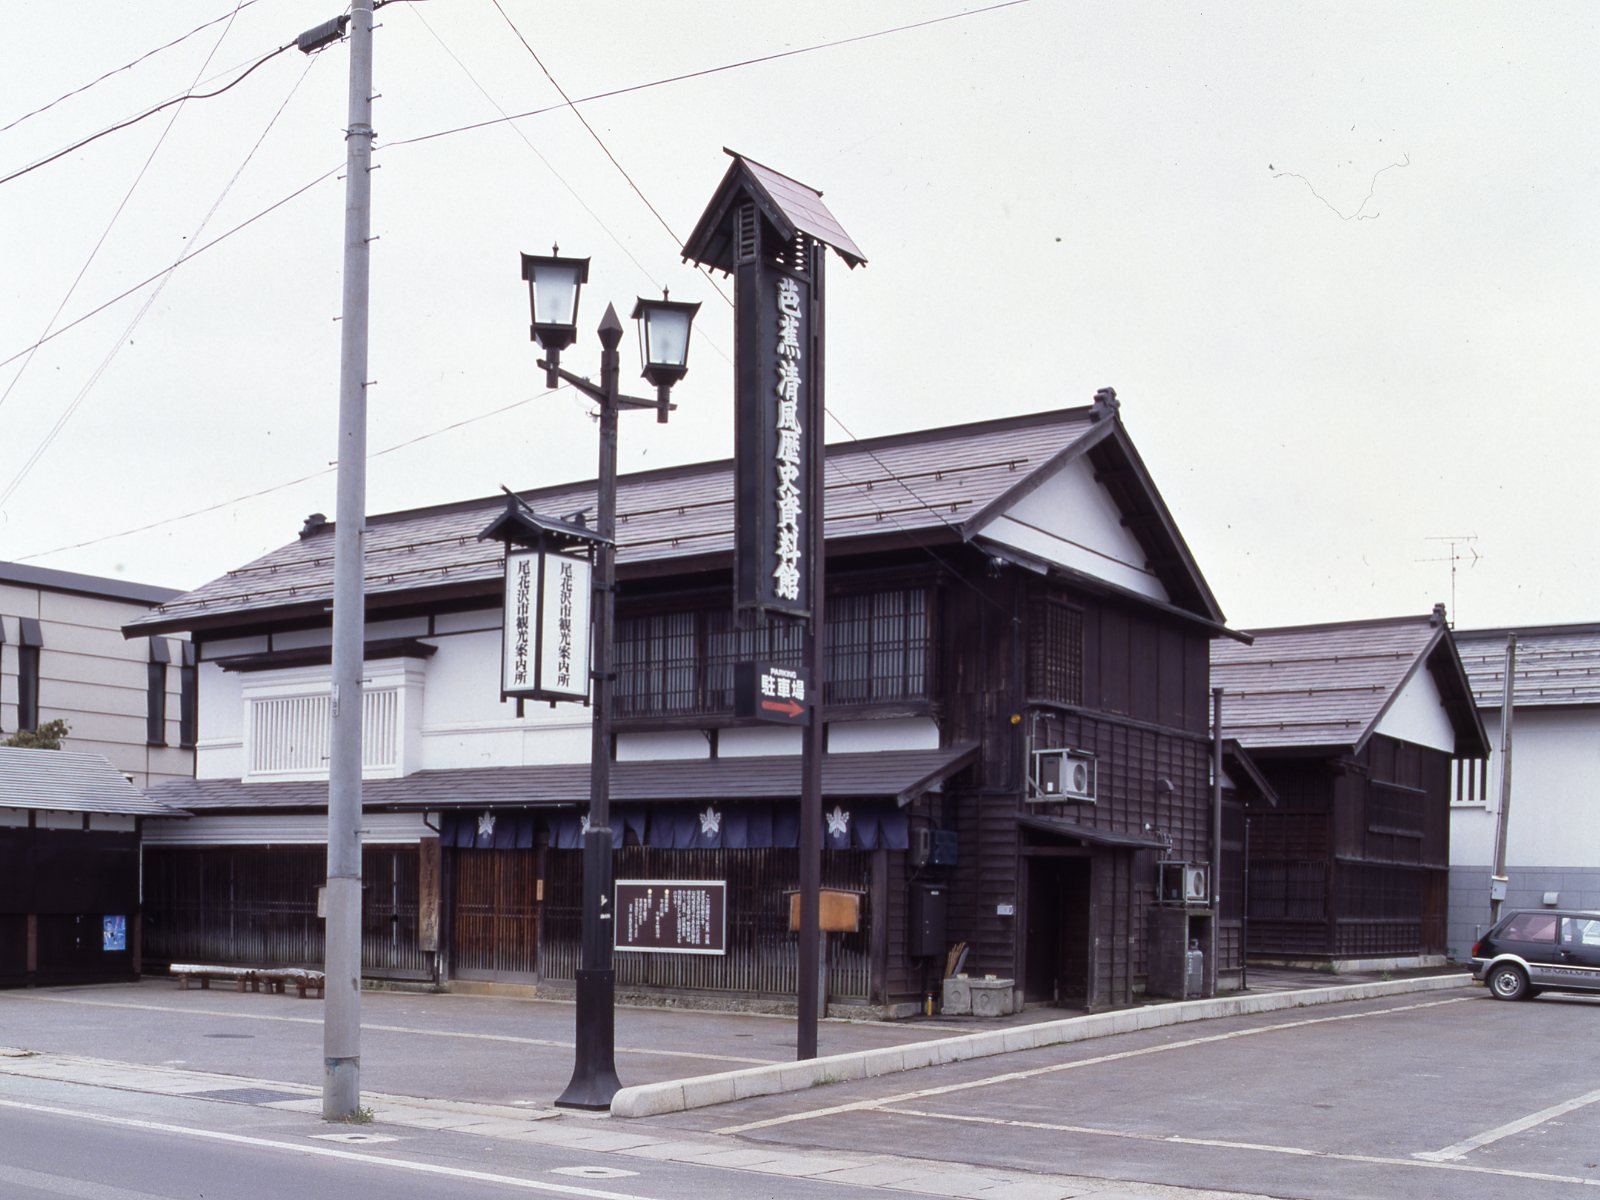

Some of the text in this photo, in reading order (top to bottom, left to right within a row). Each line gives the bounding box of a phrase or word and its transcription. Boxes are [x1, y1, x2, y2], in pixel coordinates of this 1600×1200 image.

[774, 277, 802, 600] 芭蕉清風歴史資料館
[514, 560, 531, 685] 尾花沢市観光案内所
[557, 562, 573, 688] 尾花沢市観光案内所
[761, 674, 805, 701] 駐車場
